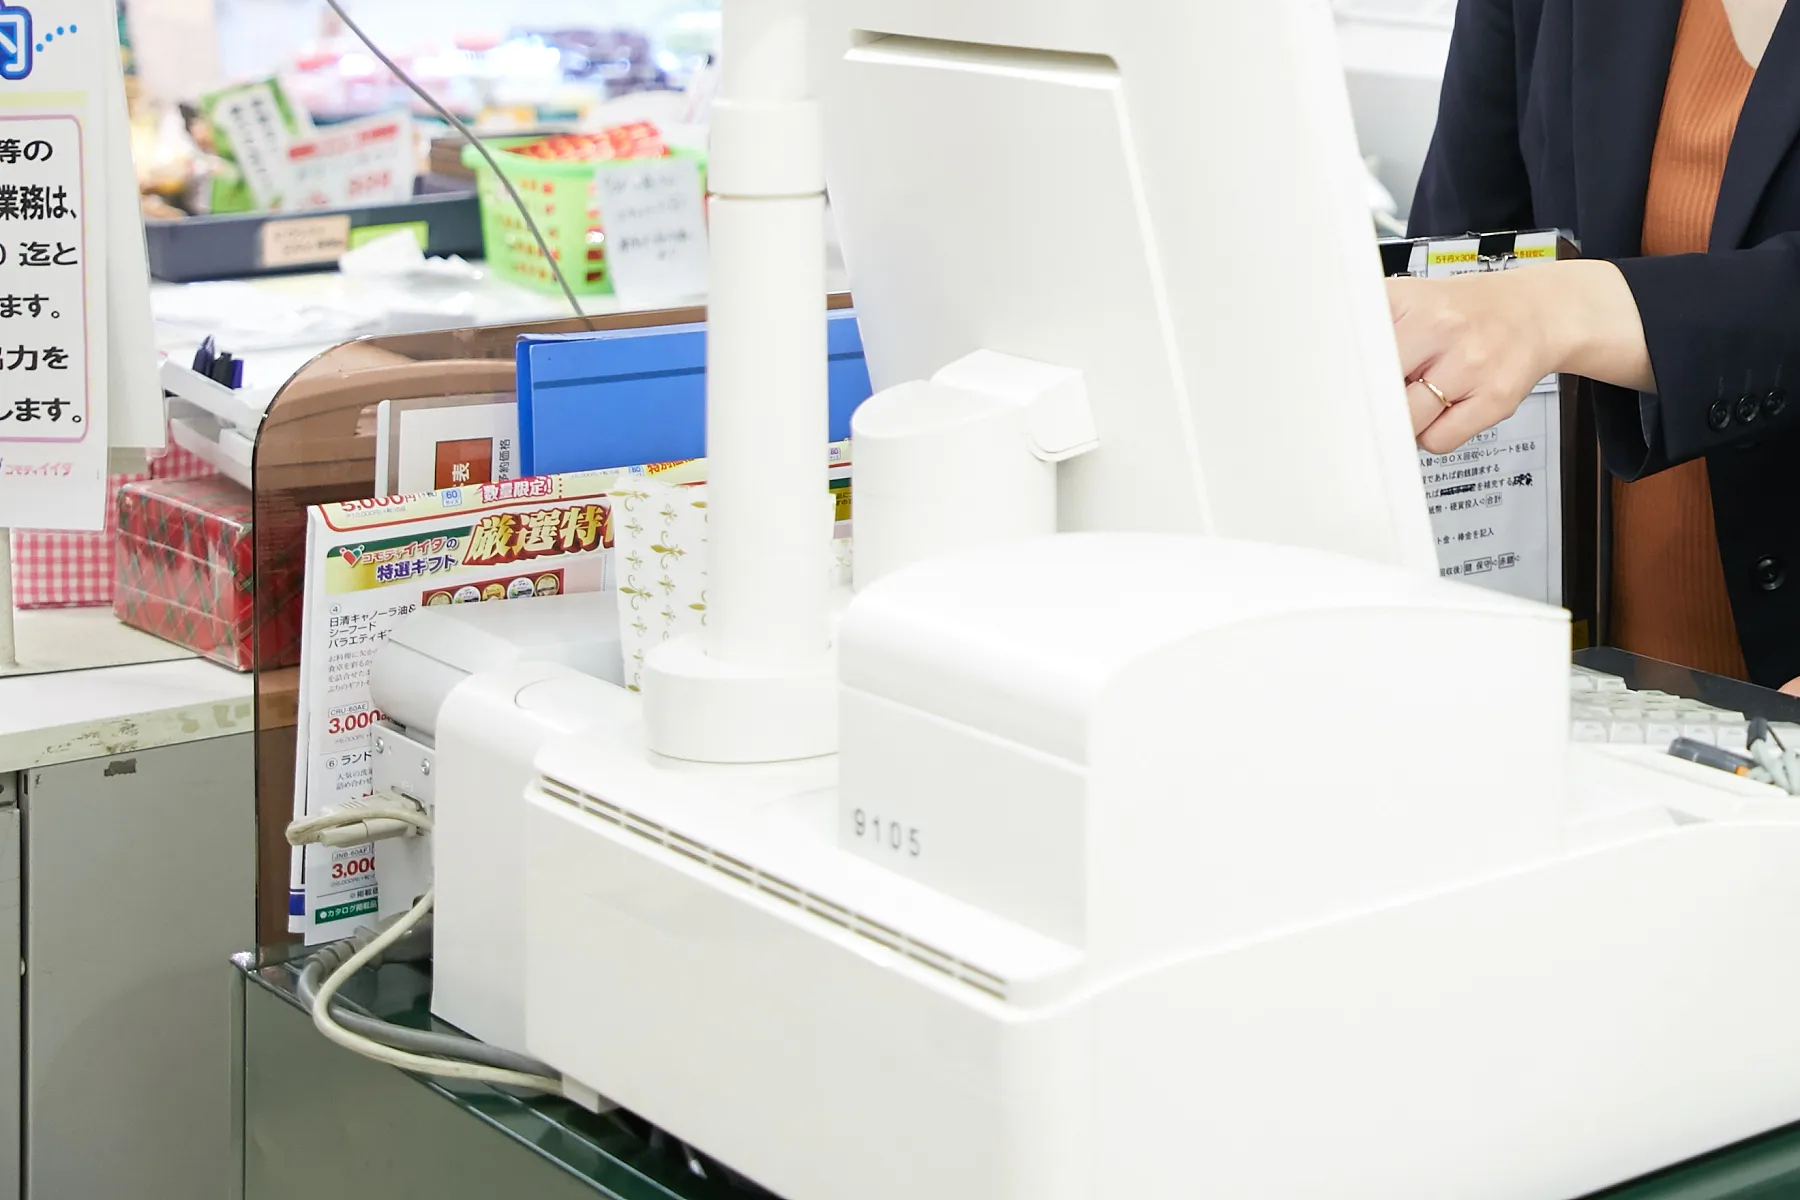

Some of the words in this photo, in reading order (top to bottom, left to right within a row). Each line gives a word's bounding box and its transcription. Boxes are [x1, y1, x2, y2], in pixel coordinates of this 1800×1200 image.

[0, 345, 69, 371] 力を
[446, 490, 458, 499] 60
[482, 476, 553, 503] 数量限定!
[467, 505, 613, 563] 厳選特
[376, 554, 457, 583] 特選ギフト
[330, 621, 377, 638] シーフード
[854, 807, 921, 857] 9105
